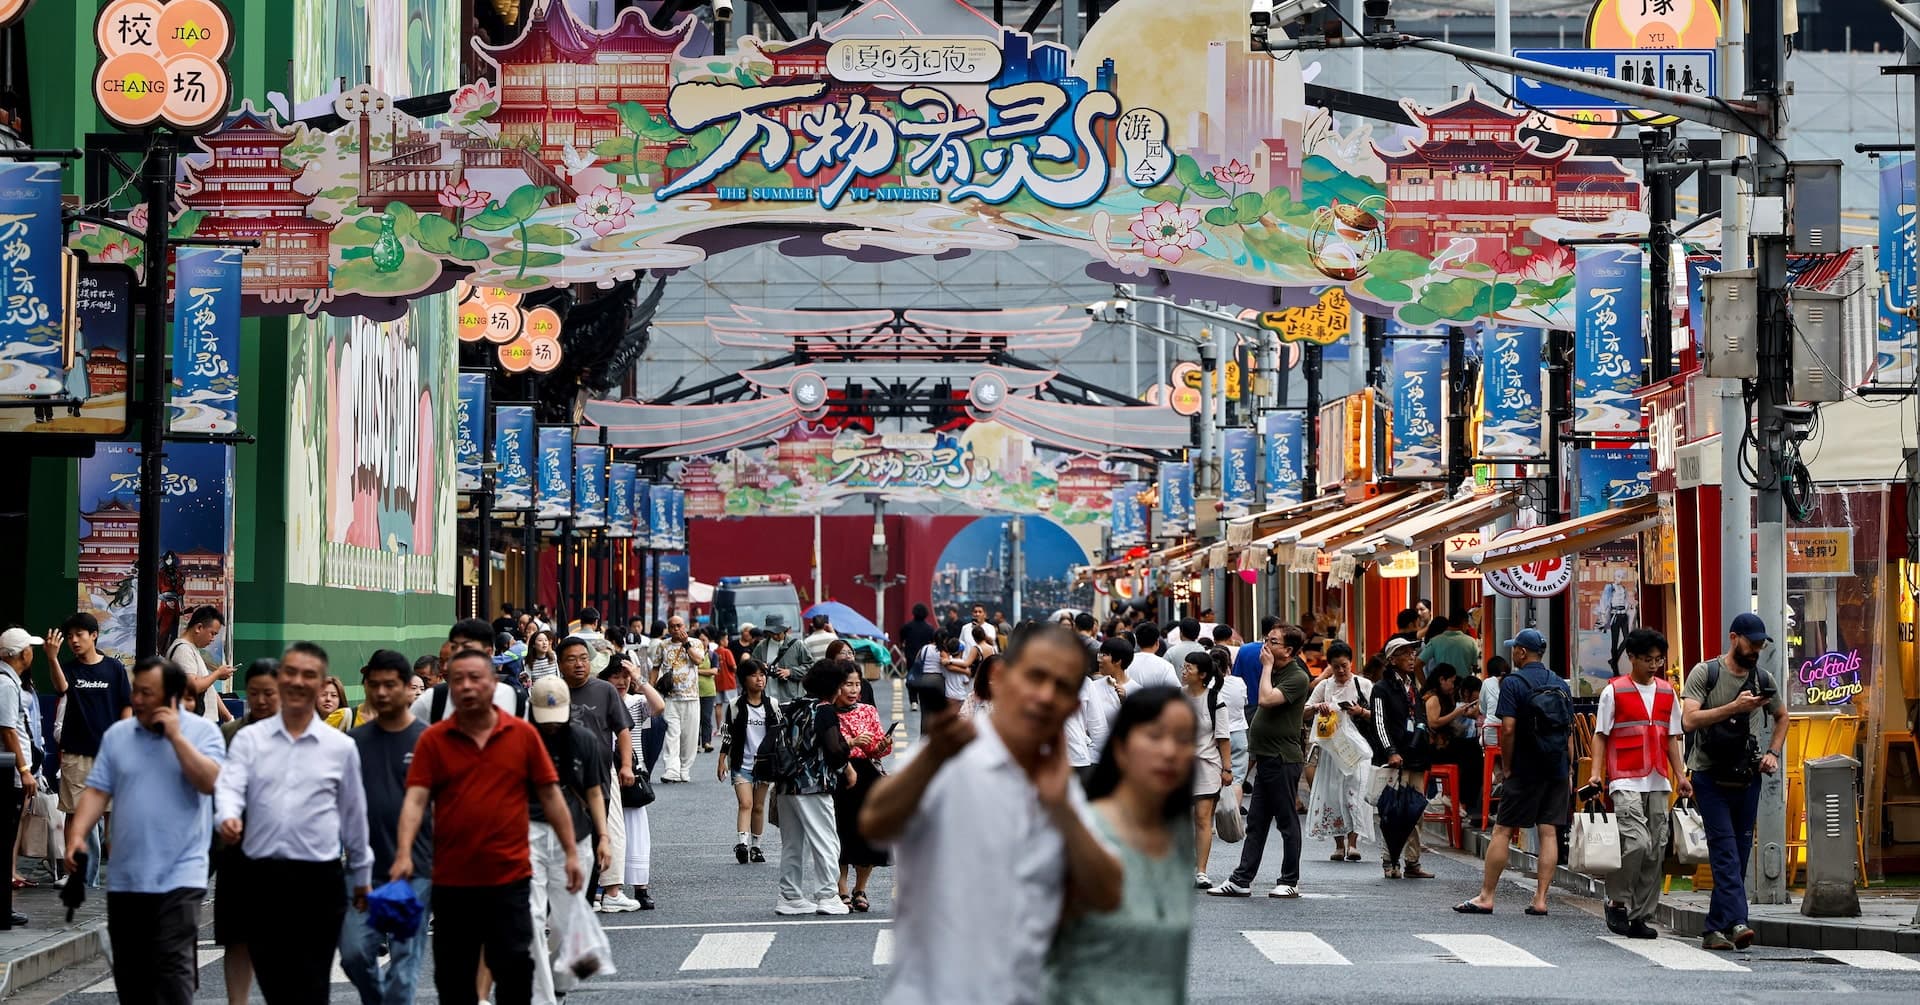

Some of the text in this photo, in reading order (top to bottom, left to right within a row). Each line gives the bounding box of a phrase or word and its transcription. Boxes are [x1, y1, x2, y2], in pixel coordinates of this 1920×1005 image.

[118, 13, 152, 46] 校
[172, 27, 211, 40] JIAO
[1649, 33, 1665, 42] YU
[103, 79, 165, 93] CHANG
[173, 71, 205, 103] 场
[656, 83, 1119, 207] 万物有灵
[717, 187, 939, 199] THE SUMMER YU-NIVERSE
[459, 316, 487, 325] HANG
[491, 312, 509, 330] 场
[533, 321, 553, 330] JIAO
[501, 348, 532, 358] CHANG
[535, 345, 552, 360] 场
[1522, 580, 1559, 592] WELFARE
[1800, 649, 1862, 683] Cocktails
[1830, 676, 1839, 688] &
[1807, 680, 1863, 704] Dreams
